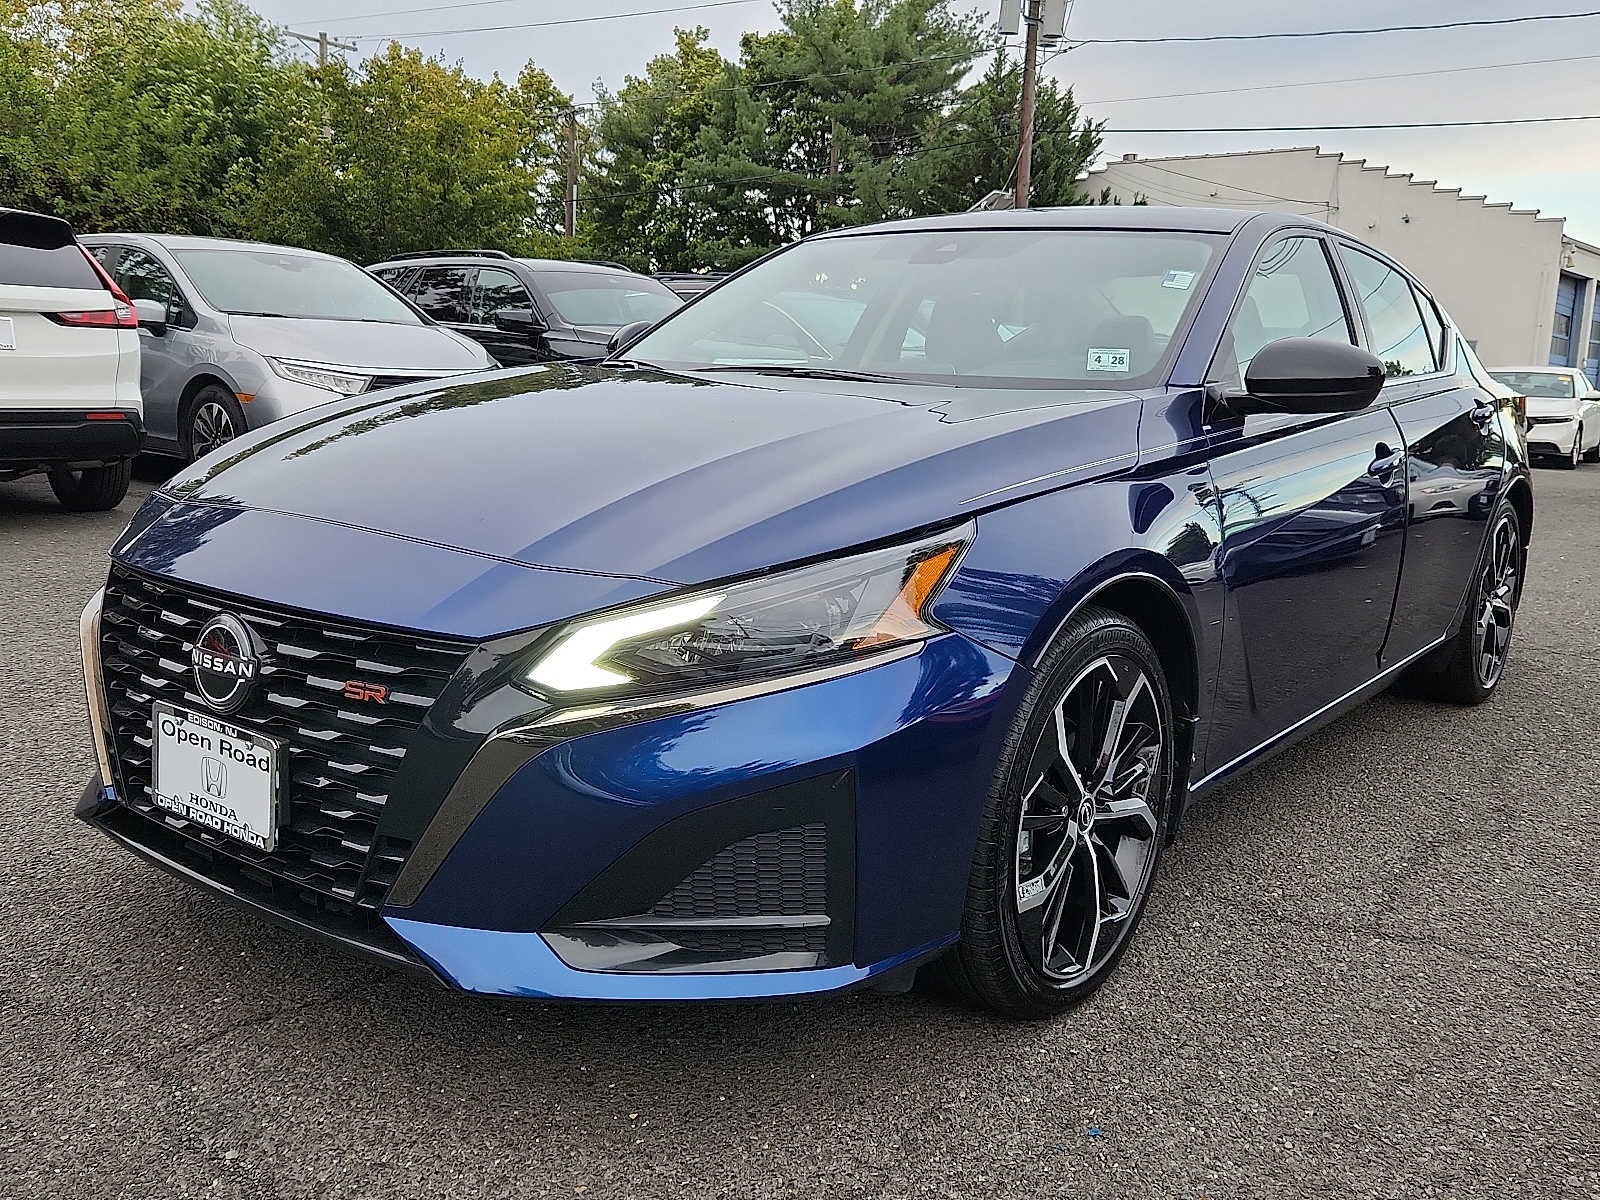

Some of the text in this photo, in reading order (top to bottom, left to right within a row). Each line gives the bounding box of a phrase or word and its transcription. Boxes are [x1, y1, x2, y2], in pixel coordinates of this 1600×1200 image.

[1094, 355, 1125, 365] 4 28
[192, 648, 253, 678] NISSAN
[344, 680, 387, 704] SR
[187, 713, 238, 738] EDISON, NJ
[161, 719, 270, 773] Open Road
[157, 795, 265, 849] OPEN ROAD HONDA
[189, 792, 239, 822] HONDA
